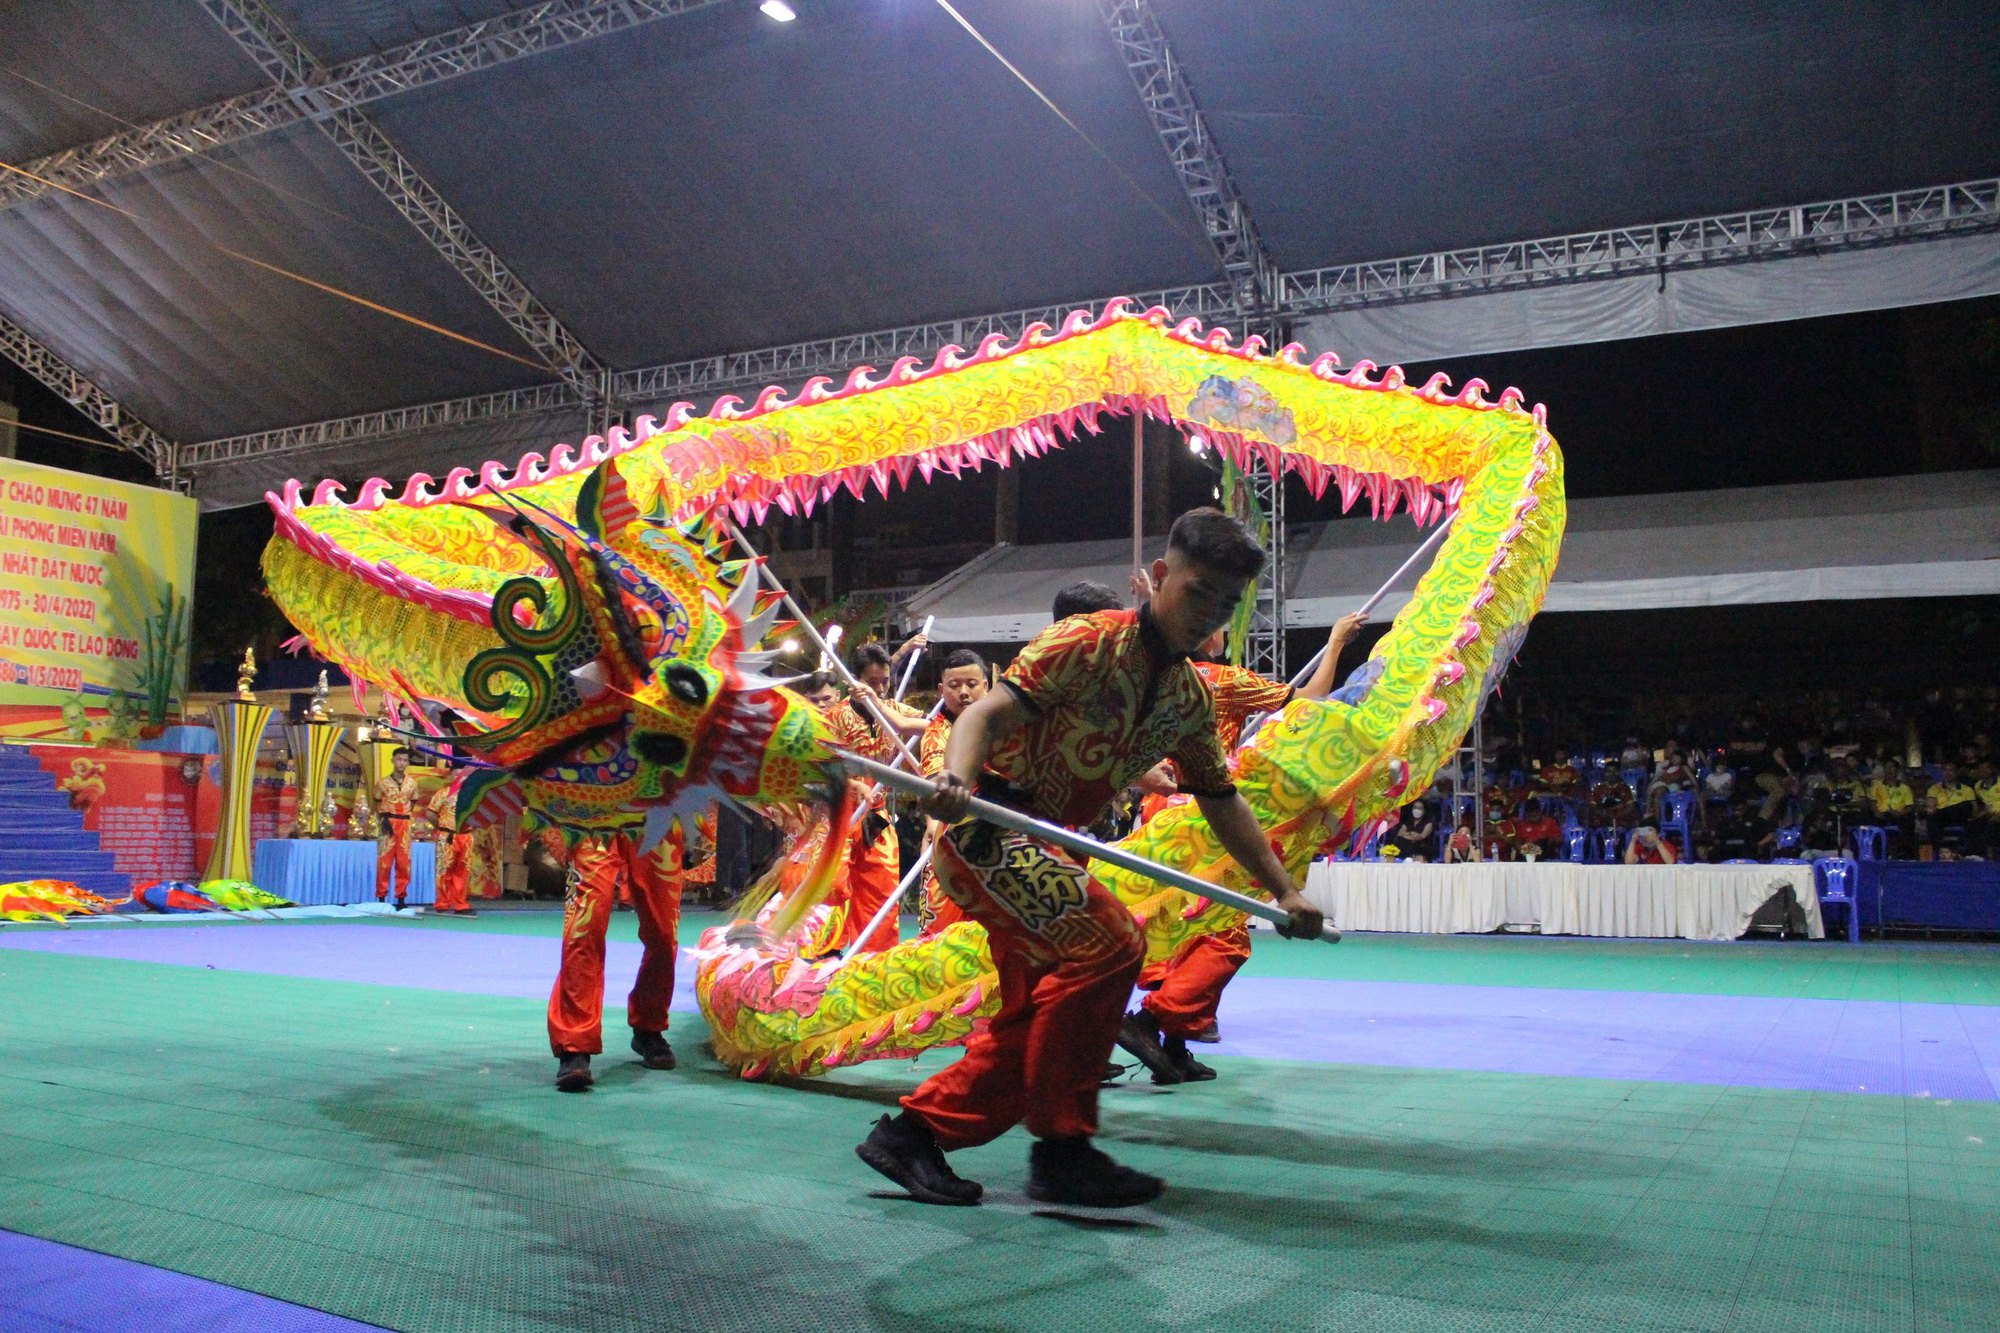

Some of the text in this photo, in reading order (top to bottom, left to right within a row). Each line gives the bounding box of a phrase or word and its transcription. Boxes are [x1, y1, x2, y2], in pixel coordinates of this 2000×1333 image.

[85, 495, 98, 515] 47
[33, 592, 96, 625] 30/4/2022)
[24, 622, 58, 651] QUỐC
[78, 633, 103, 655] LAO
[28, 664, 82, 694] 1/5/2022)
